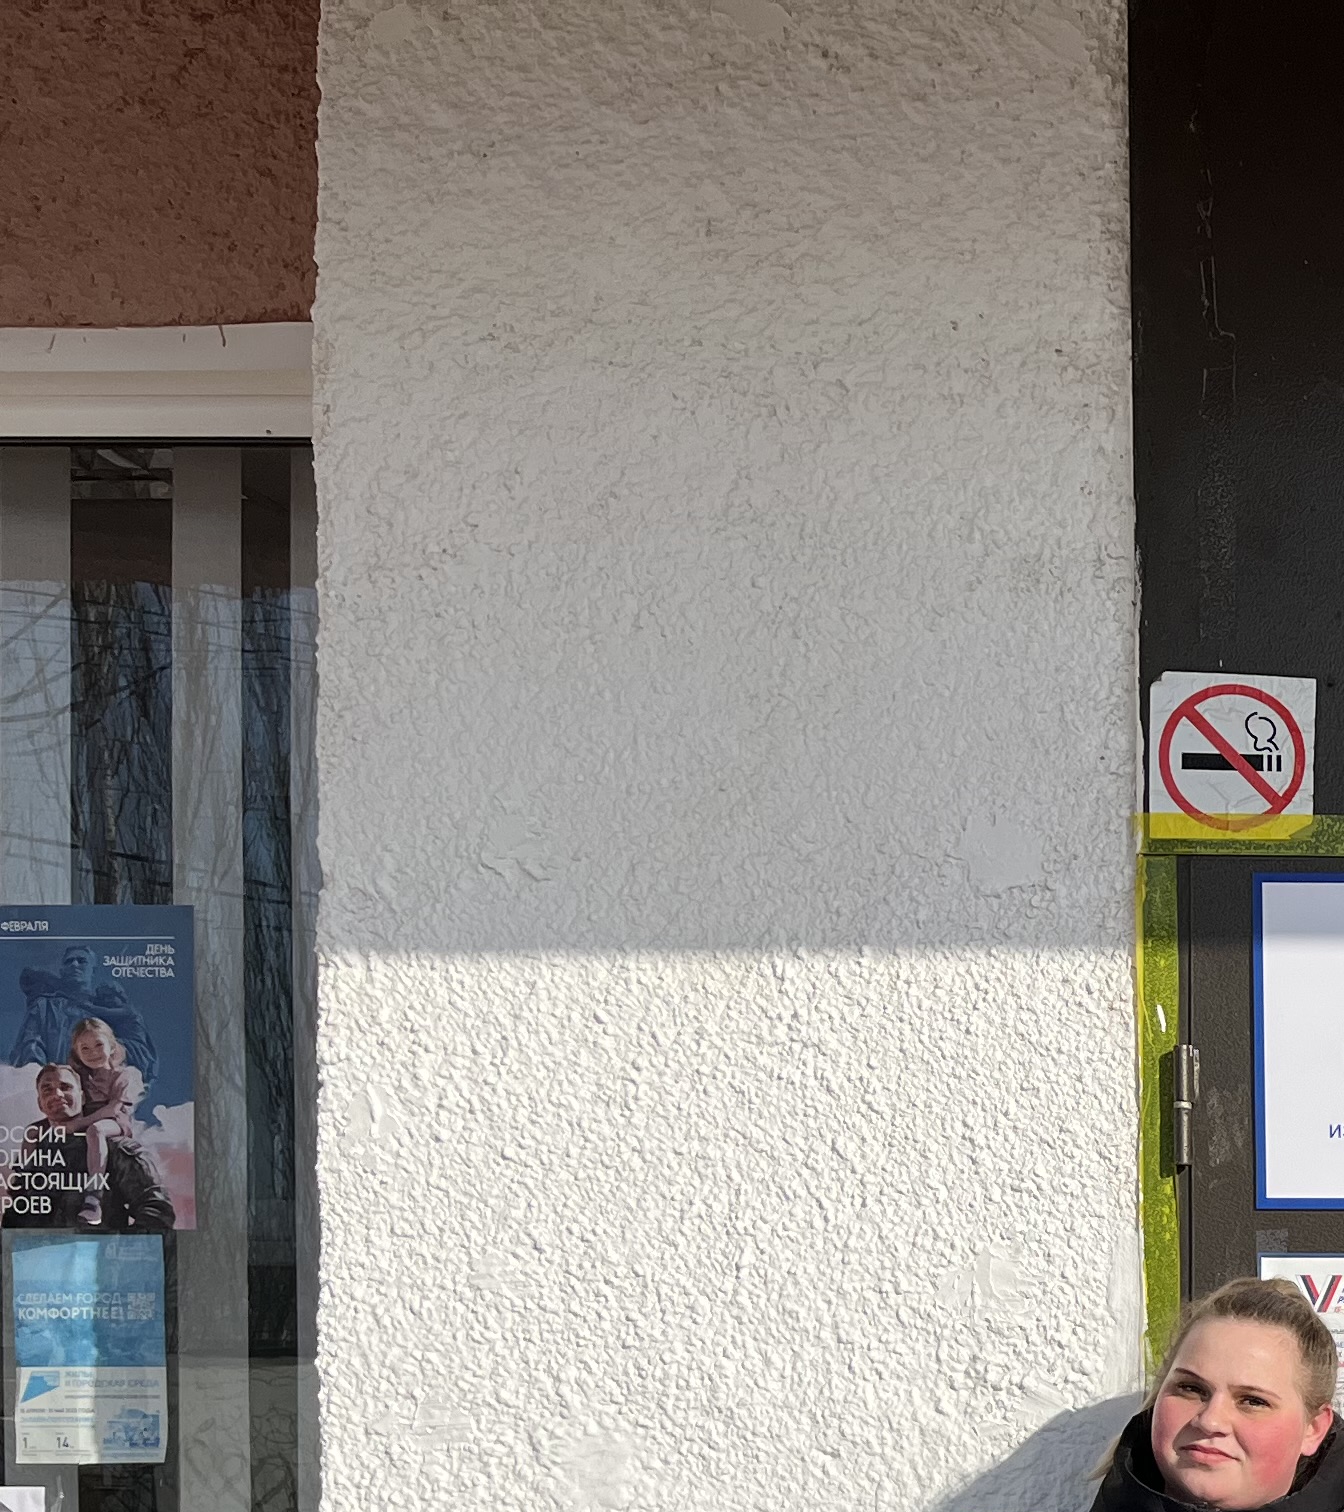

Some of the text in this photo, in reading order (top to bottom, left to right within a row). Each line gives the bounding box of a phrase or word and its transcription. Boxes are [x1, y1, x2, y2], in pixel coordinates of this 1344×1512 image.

[1, 921, 49, 931] ФЕВРАЛЯ
[145, 944, 175, 955] ДЕНЬ
[103, 956, 175, 966] ЗАЩИТНИКА
[112, 967, 175, 978] ОТЕЧЕСТВА
[0, 1126, 66, 1143] ОССИЯ
[0, 1149, 66, 1169] ОДИНА
[0, 1173, 110, 1193] АСТОЯЩИХ
[0, 1196, 51, 1214] РОЕВ
[18, 1293, 73, 1304] СДЕЛАЕМ
